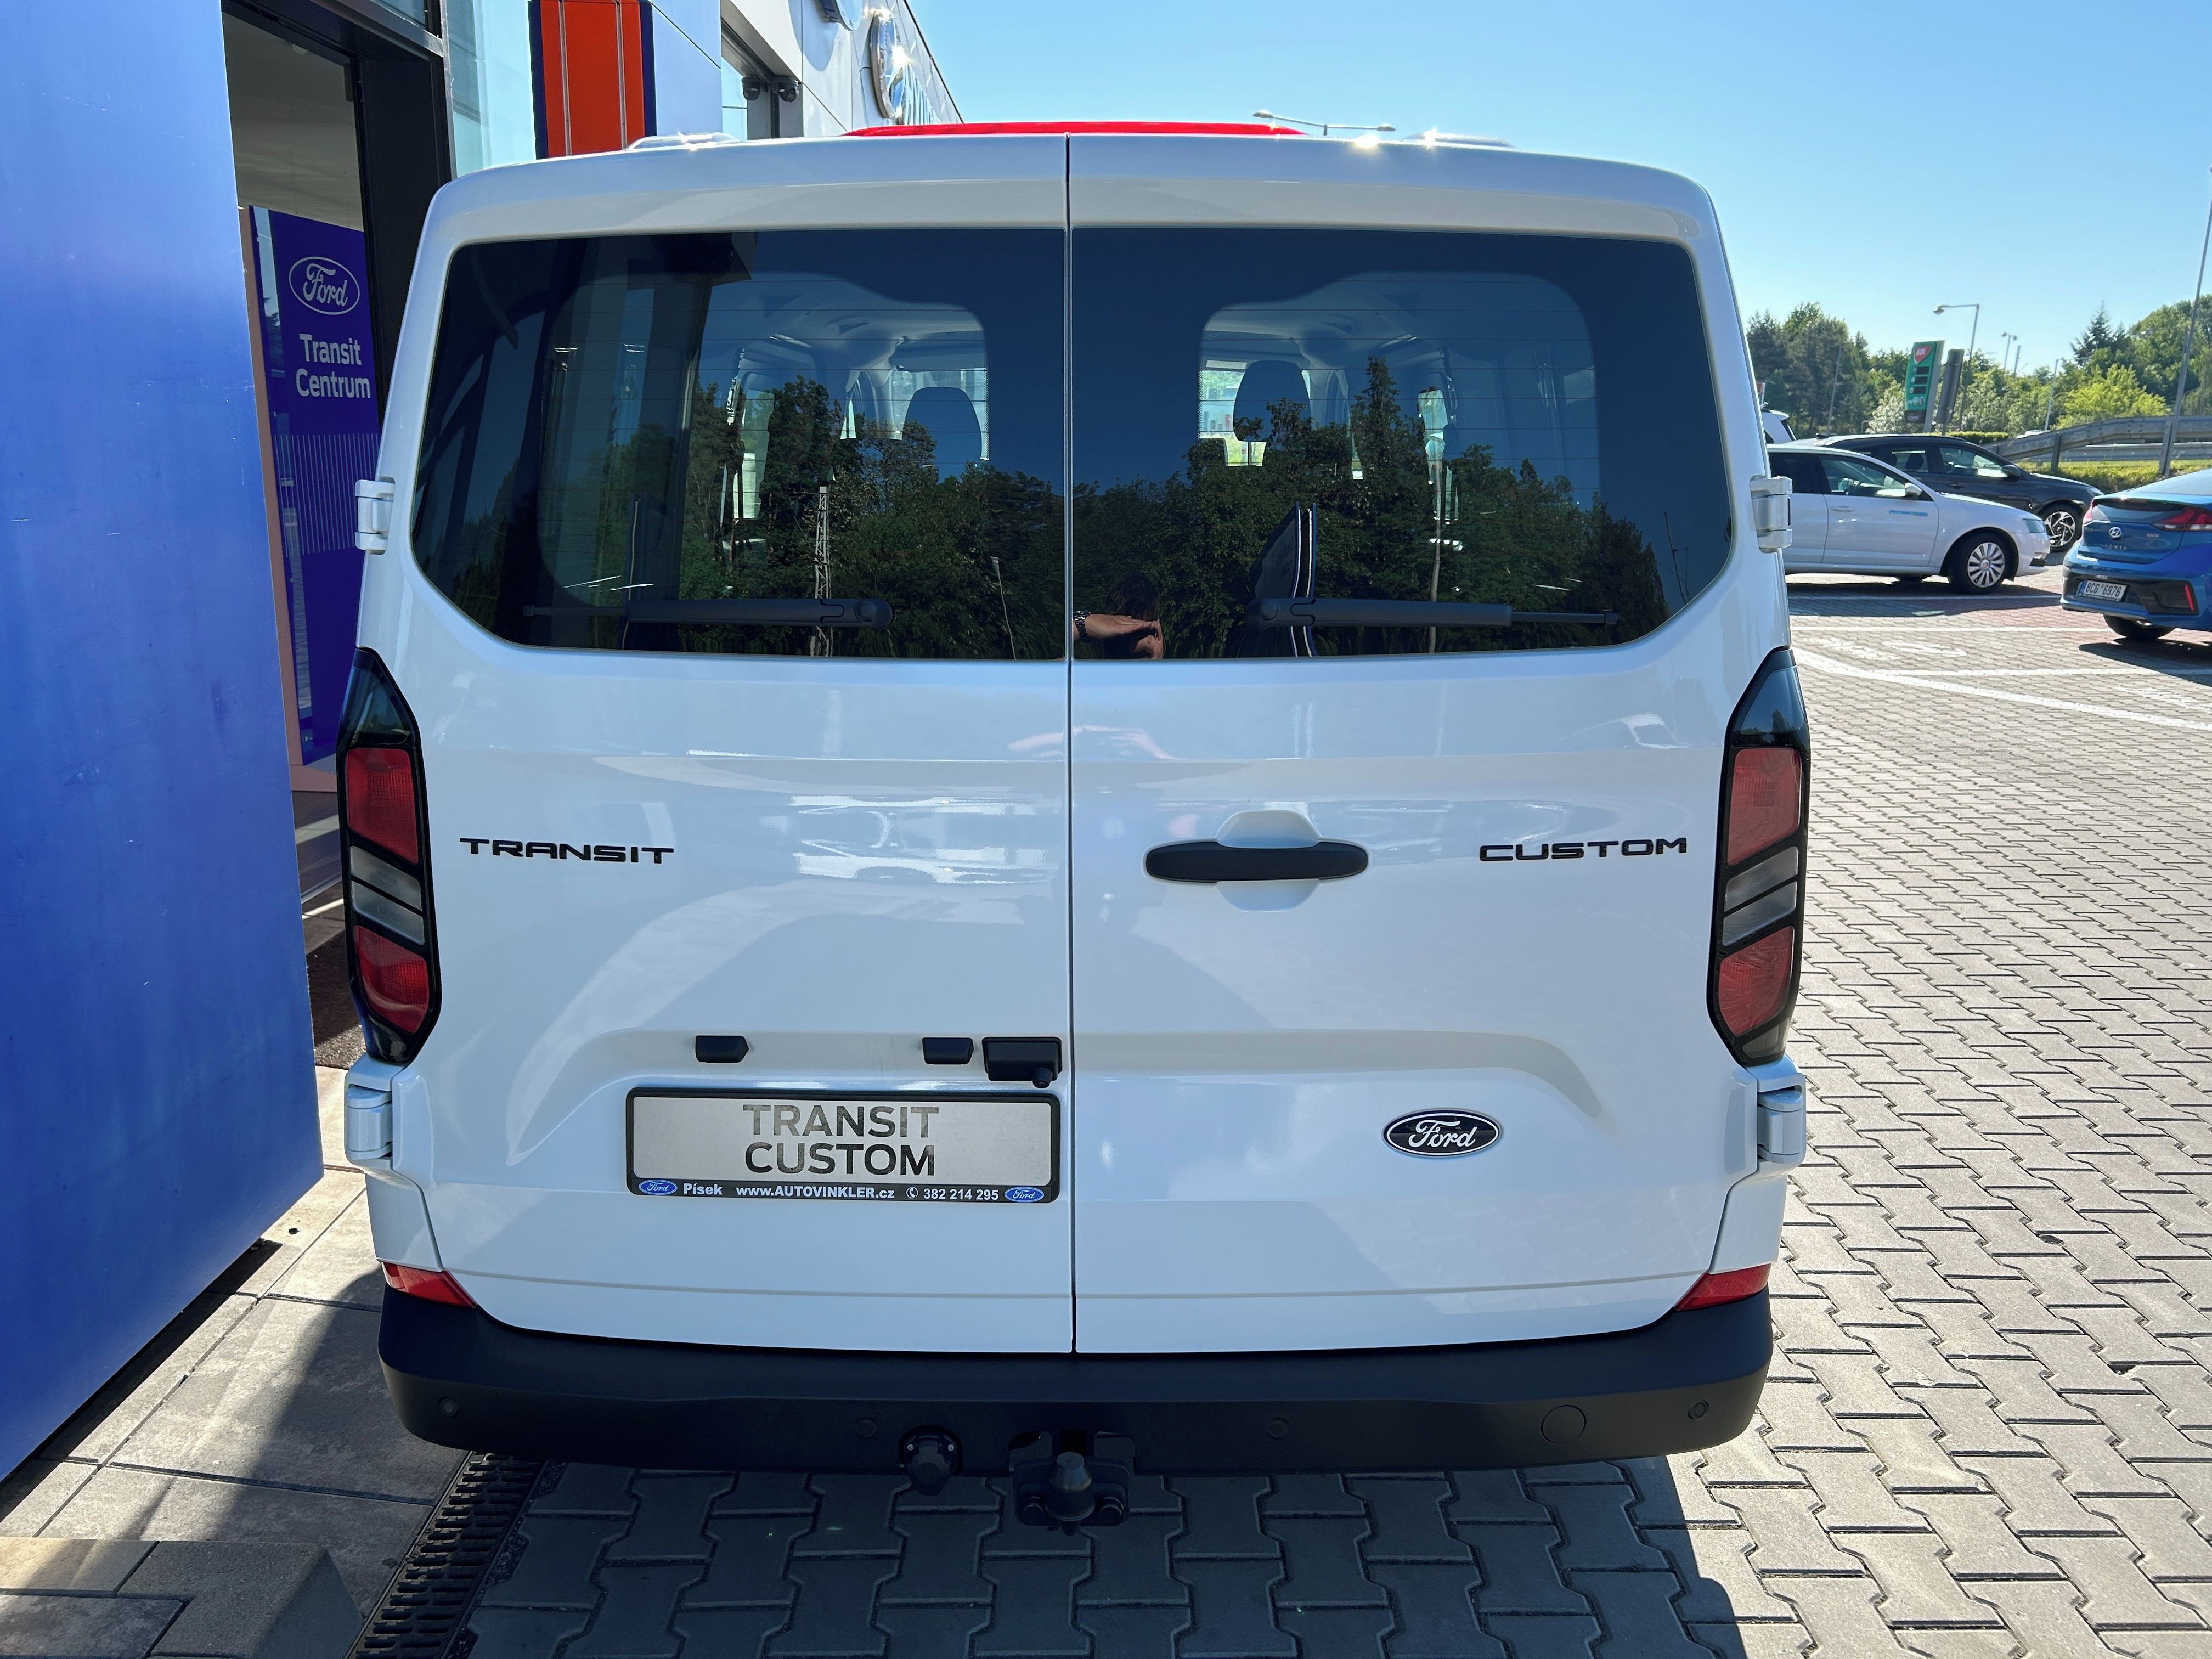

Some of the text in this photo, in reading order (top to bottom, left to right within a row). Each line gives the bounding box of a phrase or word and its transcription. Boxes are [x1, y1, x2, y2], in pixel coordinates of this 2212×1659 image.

[303, 263, 348, 307] Ford
[299, 333, 362, 365] Transit
[296, 368, 371, 398] Centrum
[2085, 583, 2122, 597] 8C6 6976
[460, 838, 674, 864] TRANSIT
[1480, 837, 1687, 861] CUSTOM
[743, 1104, 939, 1138] TRANSIT
[1408, 1120, 1478, 1148] Ford
[745, 1142, 935, 1176] CUSTOM
[646, 1182, 1035, 1201] Ford Písek www.AUTOVINKLER.cz 382 214 295 Ford
